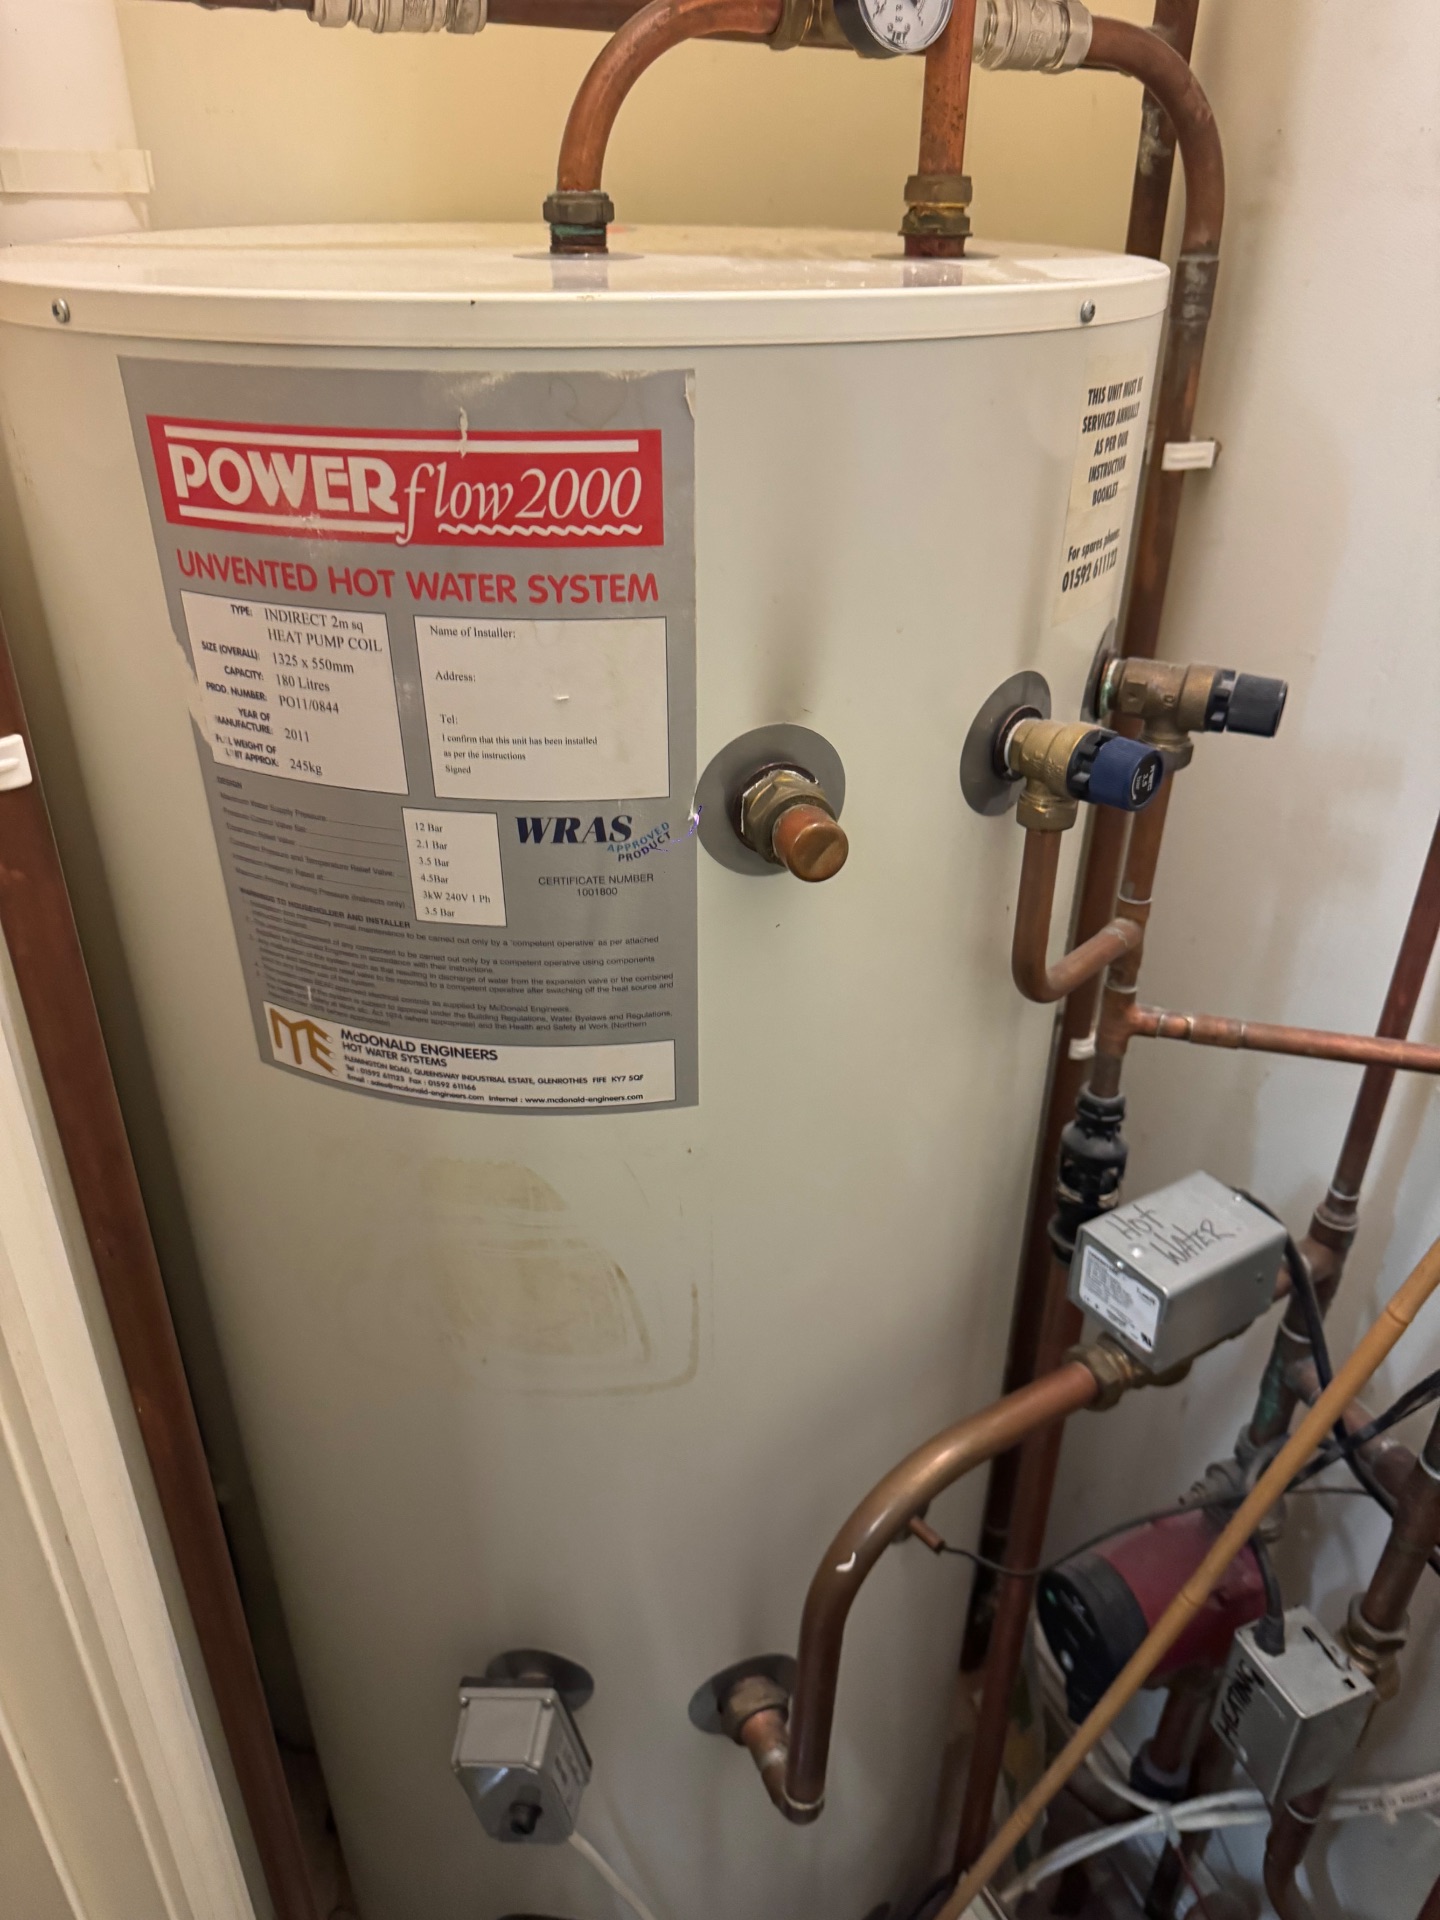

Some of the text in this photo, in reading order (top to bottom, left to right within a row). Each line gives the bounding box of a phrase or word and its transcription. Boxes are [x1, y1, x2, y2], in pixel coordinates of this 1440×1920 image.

[1088, 386, 1106, 406] THIS
[1107, 383, 1122, 403] UNIT
[1082, 411, 1116, 434] SERVICED
[1094, 439, 1104, 457] AS
[1104, 434, 1116, 453] PER
[1088, 455, 1127, 483] INSTRUCTION
[1092, 481, 1119, 507] BOOKLET
[1068, 546, 1080, 562] For
[1081, 536, 1103, 557] spares
[177, 549, 659, 603] UNVENTED HOT WATER SYSTEM
[1062, 562, 1092, 593] 01592
[264, 608, 327, 628] INDIRECT
[332, 616, 349, 630] 2m
[352, 621, 364, 633] sq
[267, 629, 383, 652] HEAT PUMP COIL
[430, 625, 516, 640] Name of Installer:
[201, 641, 218, 652] SIZE
[273, 653, 298, 667] 1325
[302, 658, 309, 668] x
[312, 657, 354, 673] 550mm
[224, 665, 330, 692] CAPACITY: 180 Litres
[435, 671, 476, 683] Address:
[238, 707, 271, 722] YEAR OF
[440, 714, 458, 725] Tel:
[284, 728, 310, 743] 2011
[447, 734, 478, 744] confirm
[479, 735, 495, 745] that
[495, 735, 510, 745] this
[512, 736, 527, 745] unit
[529, 736, 543, 746] has
[544, 736, 563, 746] been
[565, 735, 598, 746] installed
[233, 737, 264, 753] WEIGHT
[266, 745, 277, 755] OF
[443, 750, 526, 761] as per the instructions
[290, 758, 322, 776] 245kg
[445, 765, 472, 775] Signed
[415, 822, 443, 833] 12 Bar
[515, 815, 633, 844] WRAS
[416, 839, 448, 851] 2.1 Bar
[607, 821, 671, 853] APPROVED
[618, 831, 672, 863] PRODUCT
[418, 856, 449, 868] 3.5 Bar
[538, 873, 654, 886] CERTIFICATE NUMBER
[423, 890, 443, 901] 3kW
[445, 892, 469, 903] 240V
[479, 894, 491, 904] Ph
[425, 907, 456, 918] 3.5 Bar
[366, 915, 410, 929] INSTALLER
[625, 935, 659, 945] attached
[606, 955, 655, 966] components
[341, 1028, 498, 1061] McDONALD ENGINEERS
[343, 1041, 448, 1068] HOT WATER SYSTEMS
[408, 1076, 422, 1085] Fax
[428, 1079, 451, 1089] 01592
[537, 1077, 588, 1085] GLENROTHES
[592, 1075, 607, 1084] FIFE
[611, 1075, 627, 1083] KY7
[628, 1074, 644, 1082] 5QF
